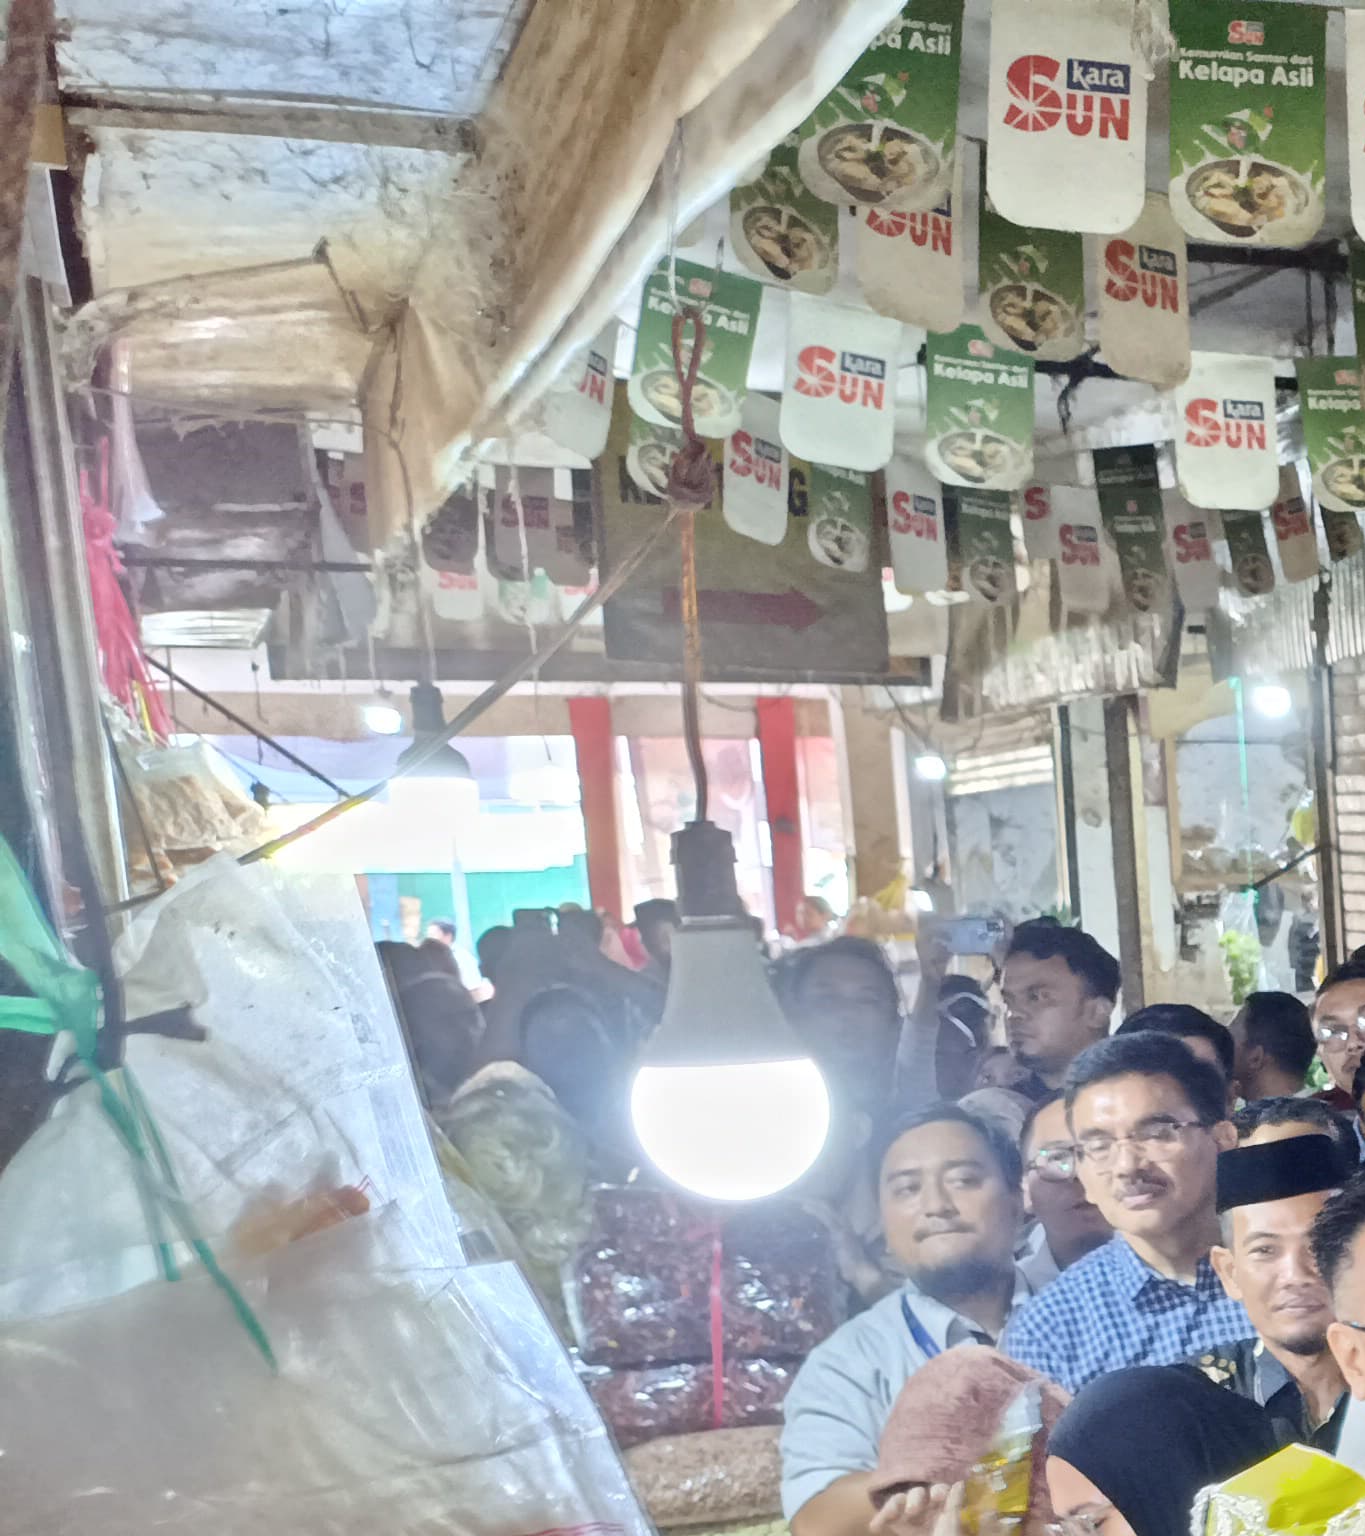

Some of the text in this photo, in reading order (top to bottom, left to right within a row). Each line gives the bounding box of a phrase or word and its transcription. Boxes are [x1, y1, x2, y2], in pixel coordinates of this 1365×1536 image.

[908, 34, 951, 55] Asli
[1003, 55, 1130, 141] SUN
[1071, 60, 1125, 91] kara
[1179, 59, 1314, 88] Kelapa Asli
[1105, 239, 1179, 314] SUN
[716, 314, 749, 336] Asli
[794, 345, 885, 410] SUN
[933, 362, 995, 385] Kelapa
[997, 371, 1028, 388] Asli
[1185, 397, 1266, 450] SUN
[730, 429, 782, 491] SUN
[892, 490, 938, 542] SUN
